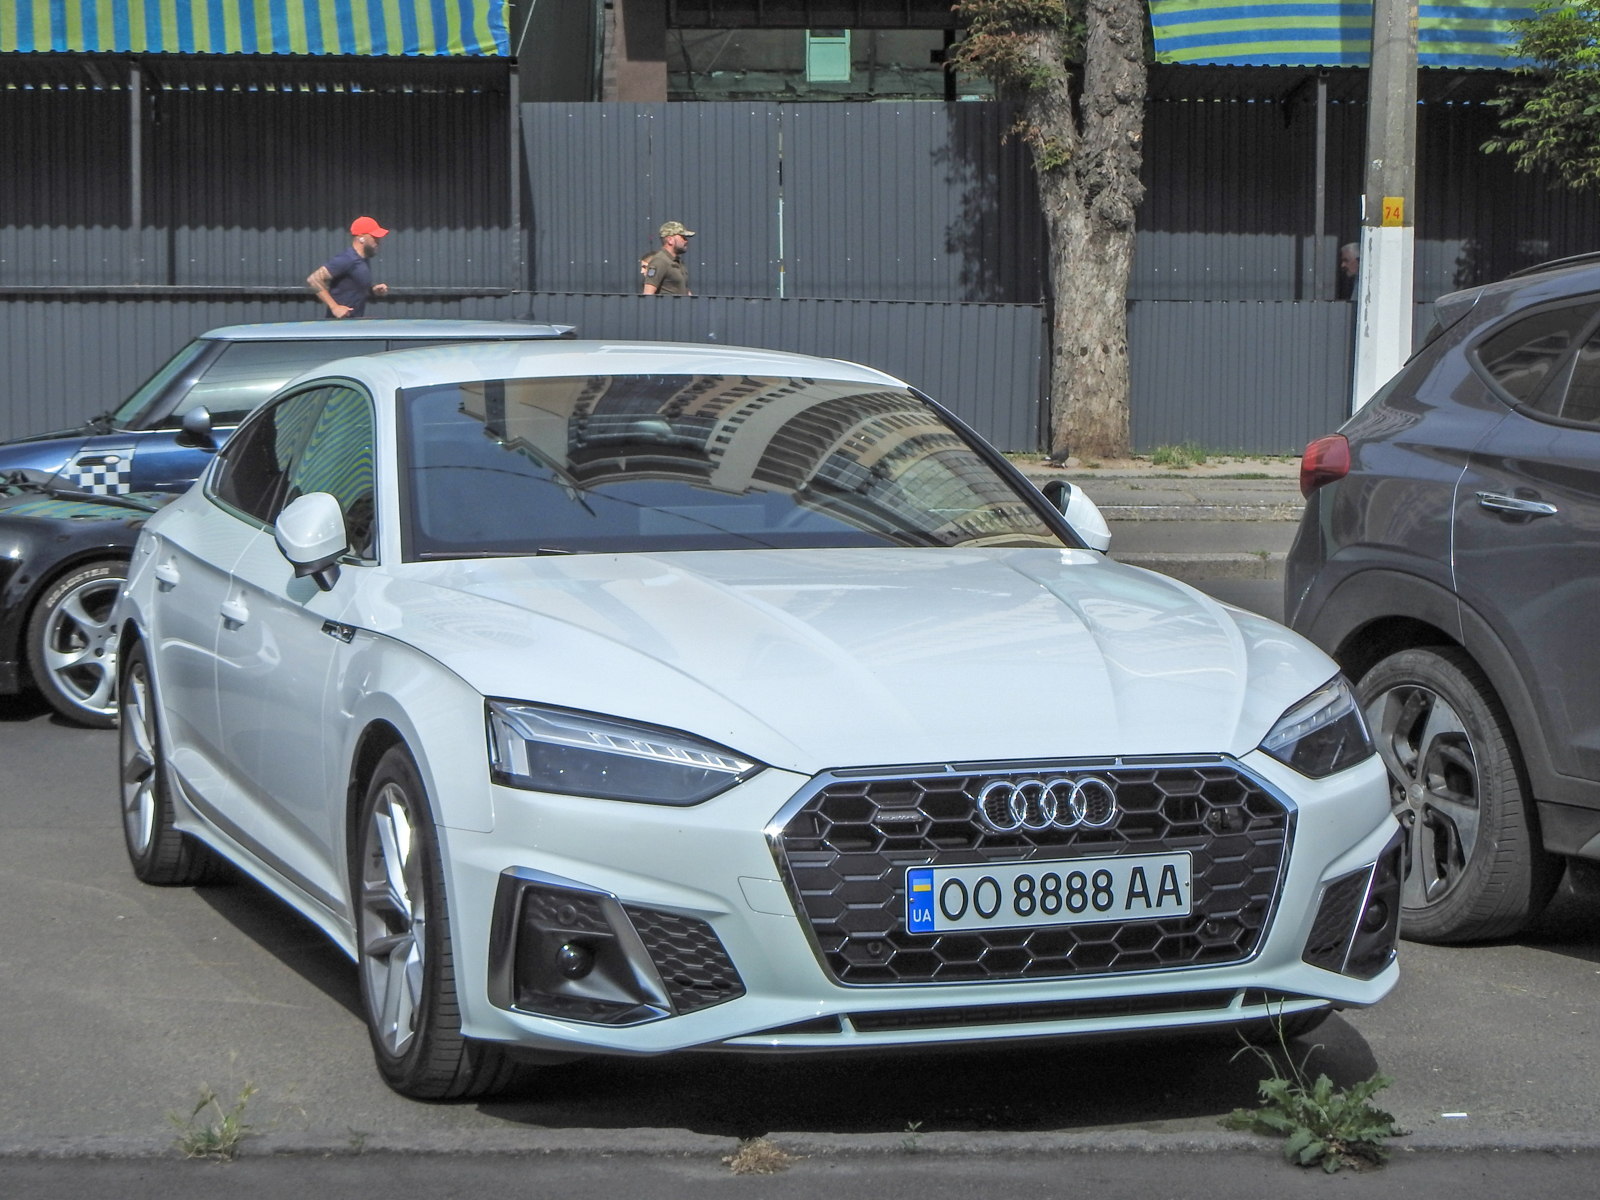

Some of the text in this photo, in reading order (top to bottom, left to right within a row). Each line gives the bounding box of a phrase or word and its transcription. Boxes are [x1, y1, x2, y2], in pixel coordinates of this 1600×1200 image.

[1385, 206, 1400, 219] 74
[1013, 868, 1114, 917] 8888
[1124, 864, 1183, 911] AA
[912, 908, 932, 923] UA
